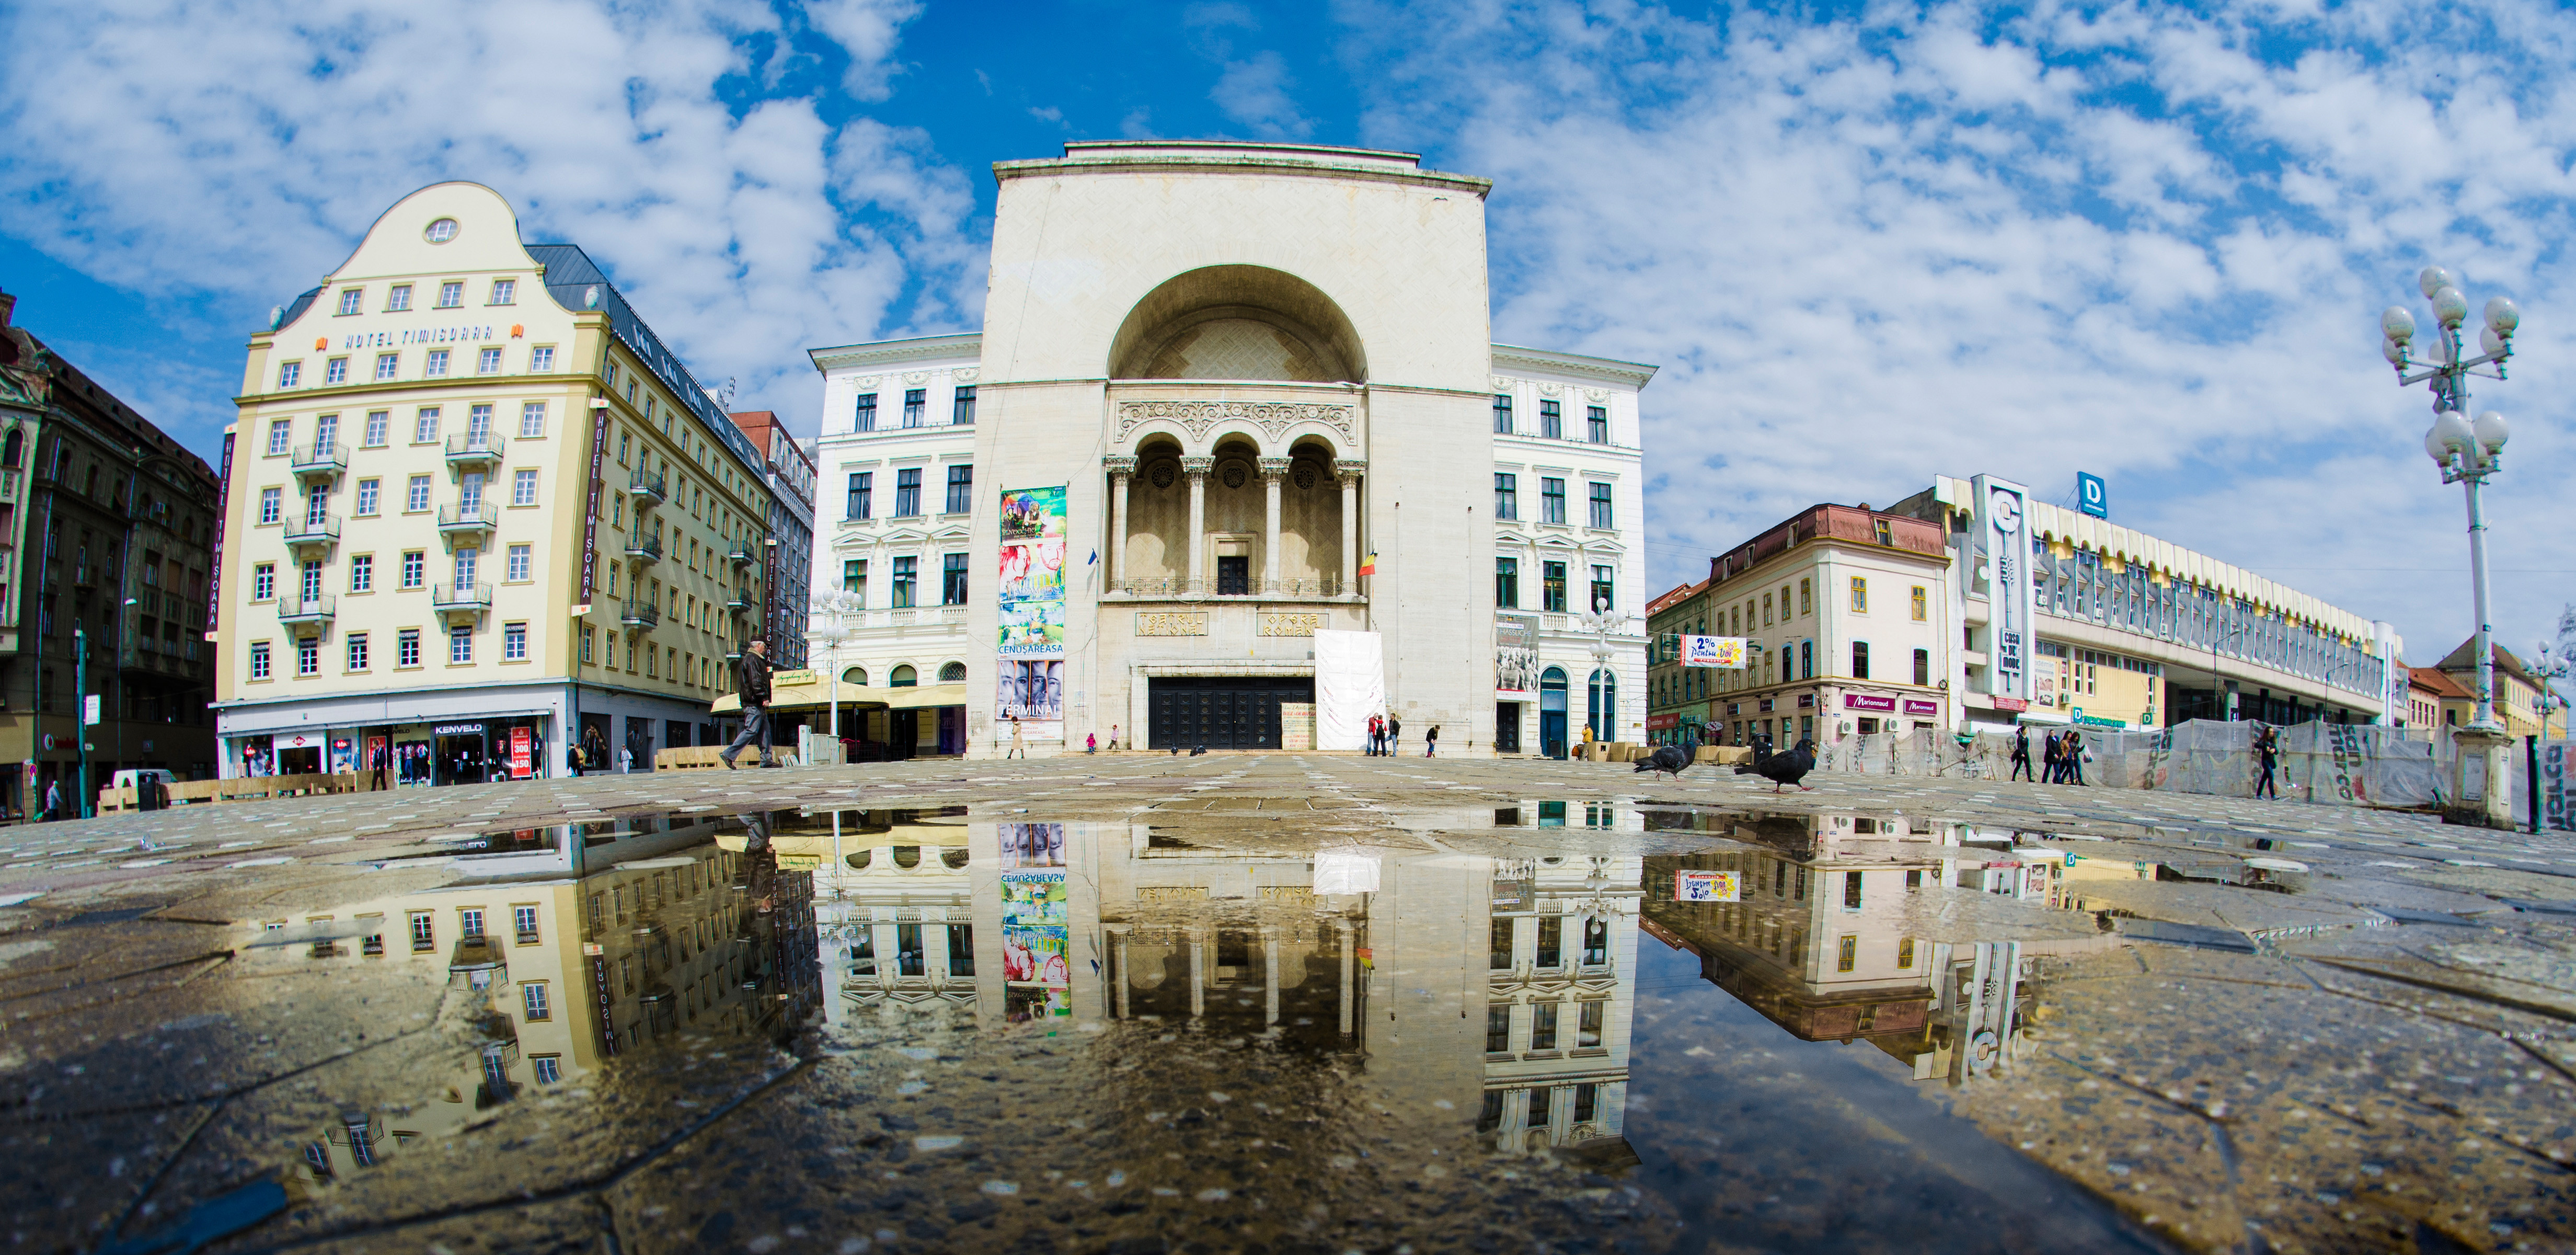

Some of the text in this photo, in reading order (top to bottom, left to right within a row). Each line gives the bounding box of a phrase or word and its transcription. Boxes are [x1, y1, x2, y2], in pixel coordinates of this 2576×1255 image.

[346, 332, 393, 349] HOTEL
[592, 416, 604, 480] HOTEL
[221, 442, 232, 506] HOTEL
[2086, 478, 2101, 504] D
[1140, 614, 1203, 624] TEATRUL
[1263, 626, 1320, 636] ROMAN
[1697, 637, 1715, 649] 2%
[2004, 632, 2020, 645] CASA
[1691, 646, 1732, 658] Pentru Voi
[2008, 645, 2016, 656] DE
[2003, 656, 2020, 670] MODE
[1853, 695, 1889, 708] Marionnaud
[1909, 702, 1934, 711] Marionnaud
[998, 704, 1058, 719] TERMINAL
[2075, 709, 2082, 720] D
[2144, 714, 2151, 723] D
[436, 724, 482, 734] KENVELO
[514, 744, 529, 753] 300
[515, 759, 529, 768] 150
[2327, 724, 2354, 801] marco
